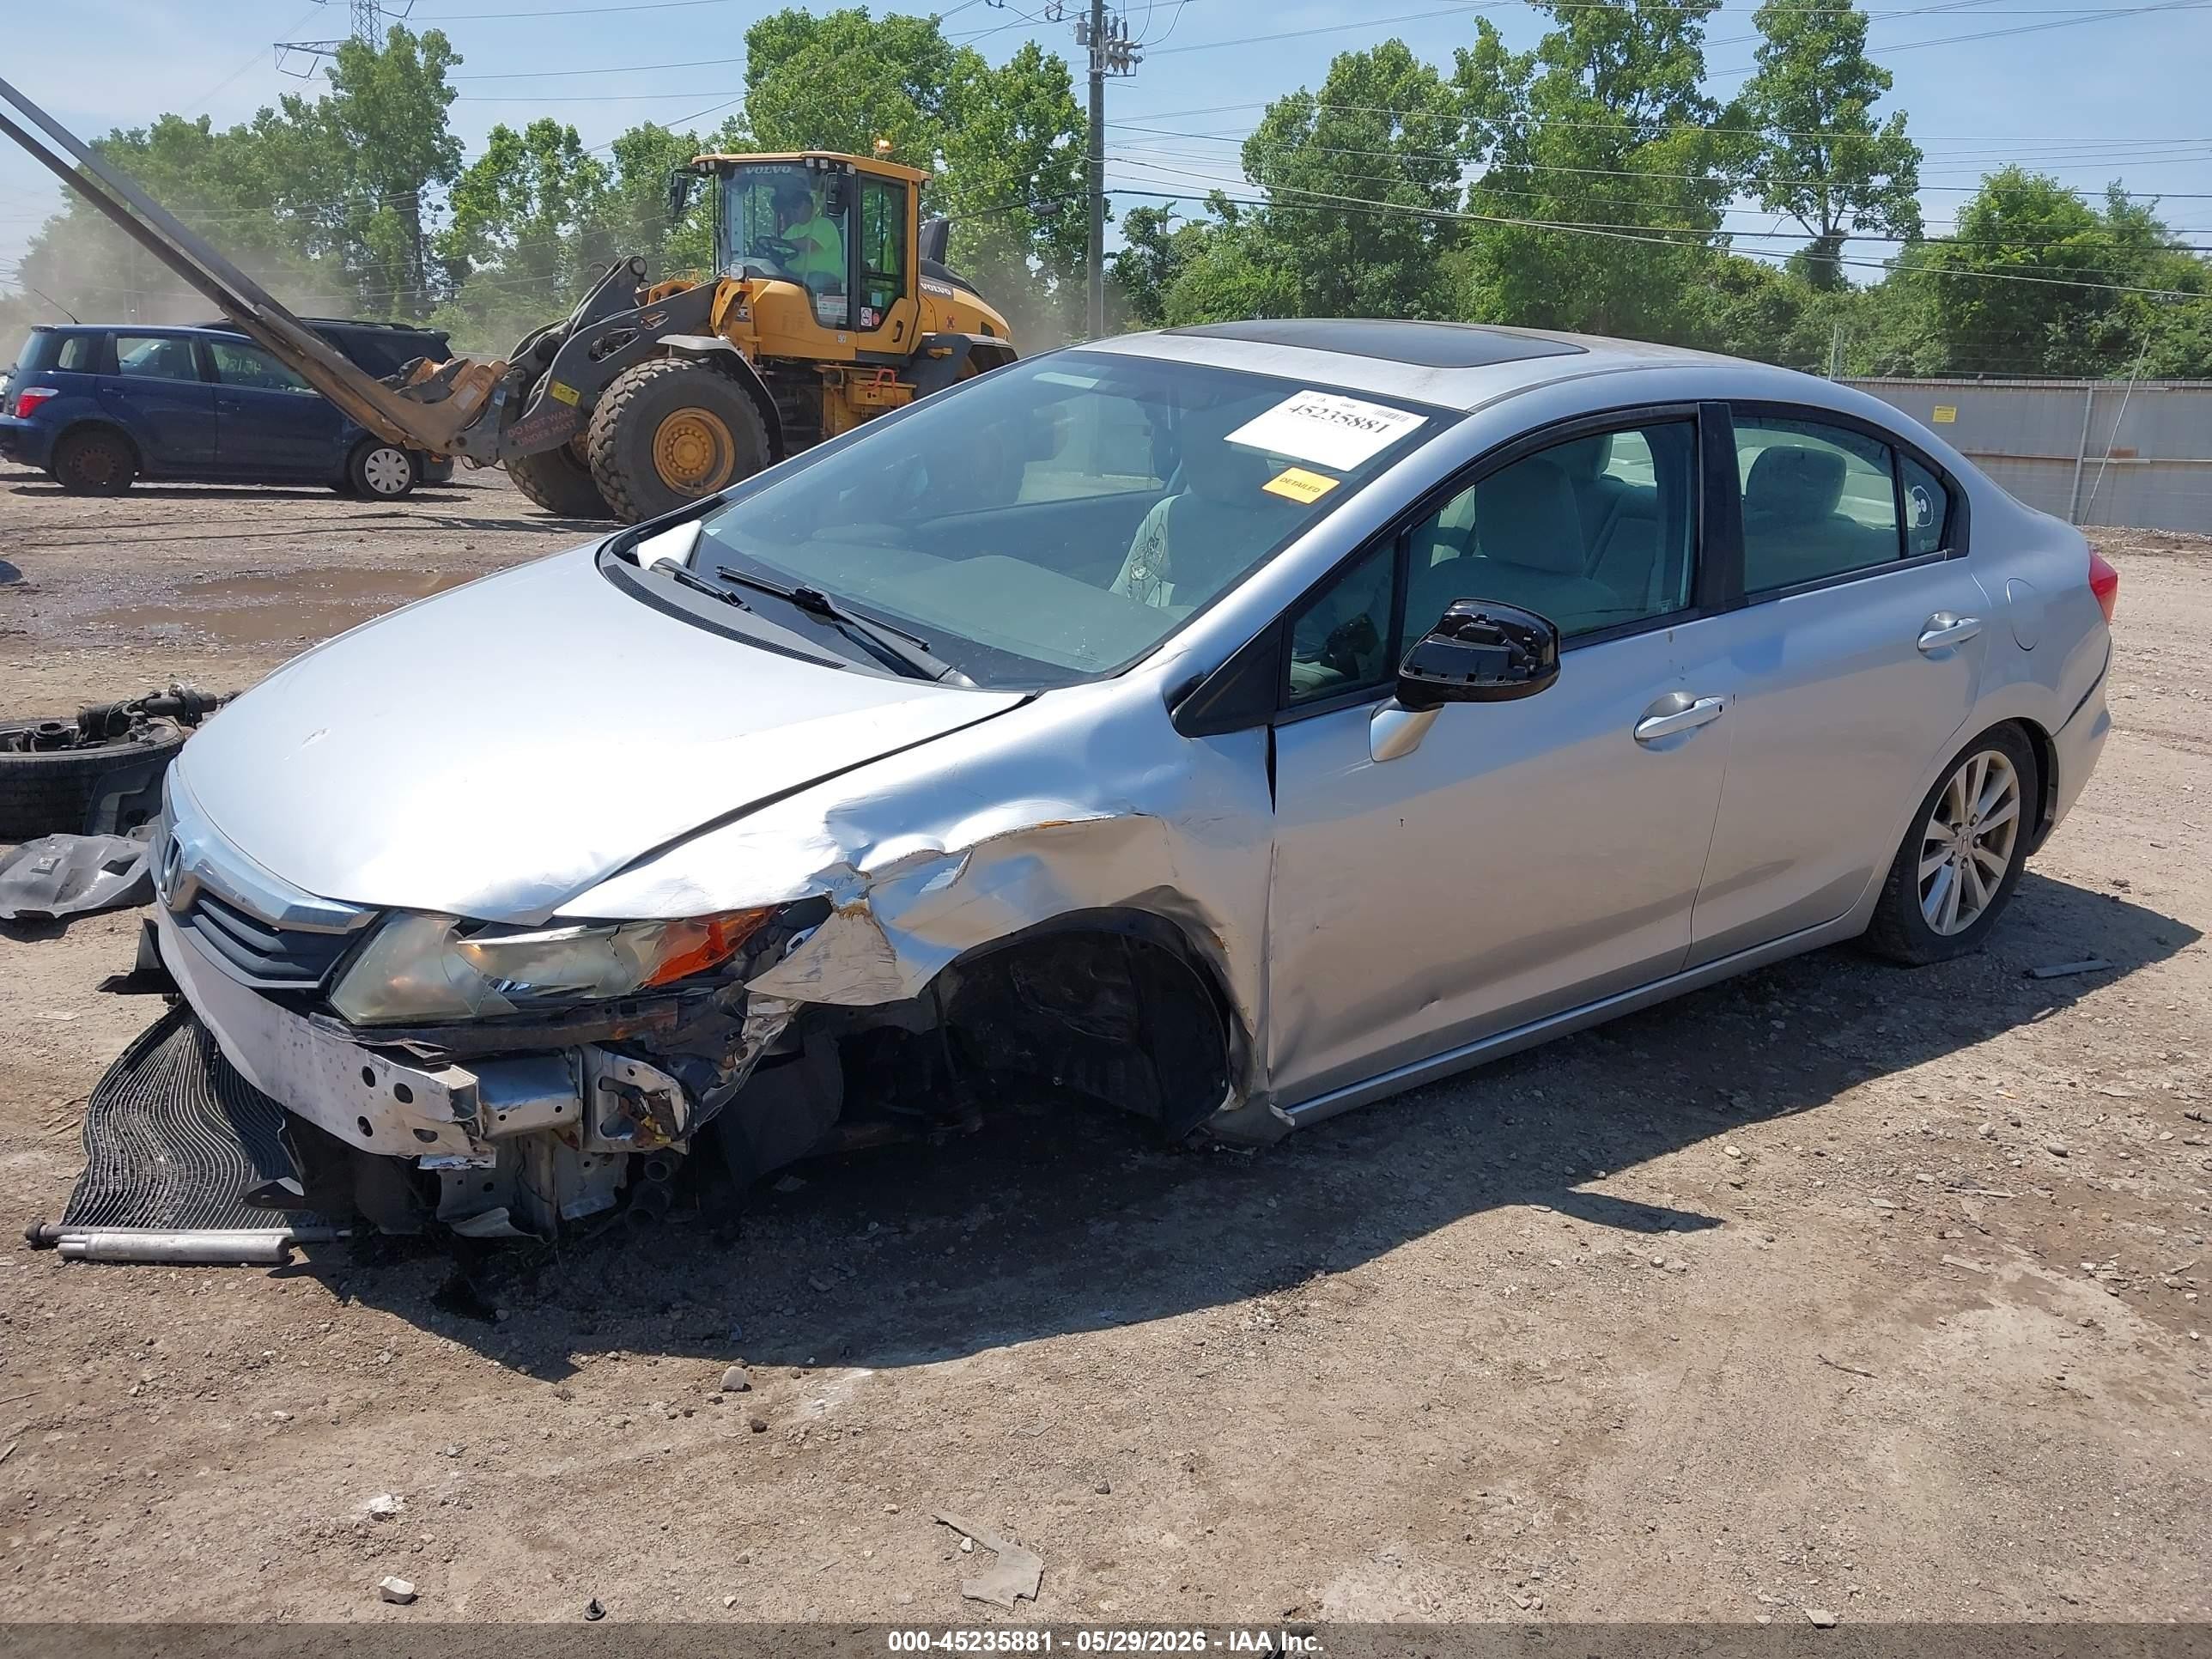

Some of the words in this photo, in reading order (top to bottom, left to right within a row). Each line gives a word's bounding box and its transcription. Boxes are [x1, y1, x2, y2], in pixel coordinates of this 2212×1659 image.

[745, 166, 792, 174] VOLVO
[921, 283, 951, 295] VOLVO
[507, 426, 523, 438] DO
[525, 417, 545, 432] NOT
[1289, 404, 1390, 434] 45235881
[517, 429, 550, 447] UNDER
[1279, 477, 1321, 493] DETAILED
